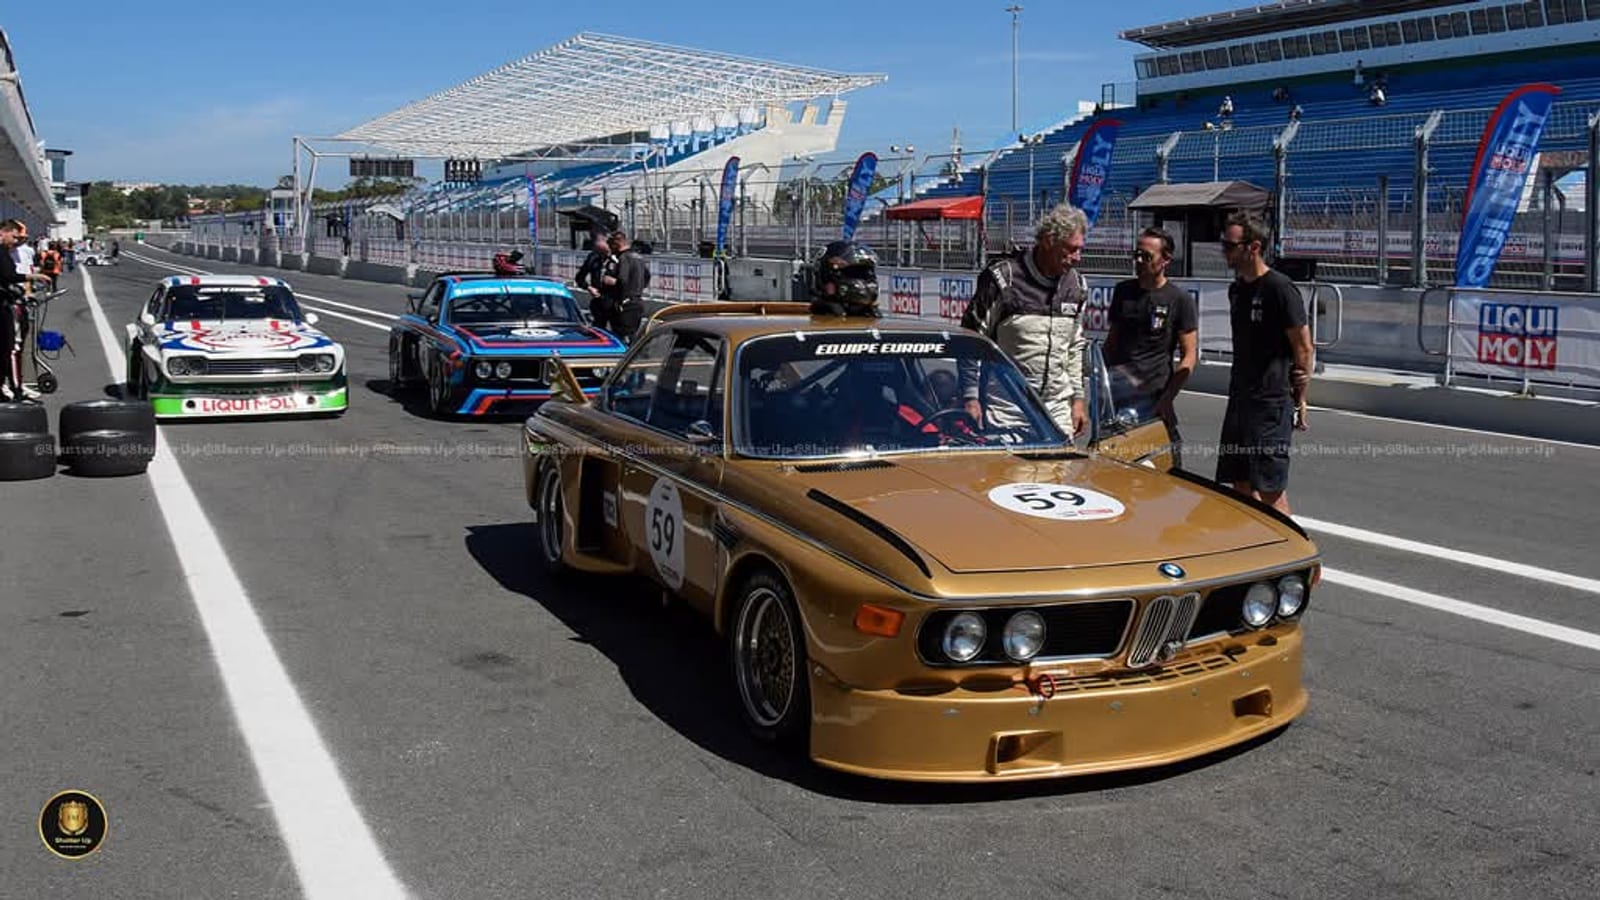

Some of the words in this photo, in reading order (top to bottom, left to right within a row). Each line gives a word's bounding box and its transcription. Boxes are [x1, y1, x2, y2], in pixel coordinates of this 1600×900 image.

[892, 277, 920, 294] LIQUI
[940, 280, 974, 298] LIQUI
[891, 295, 920, 313] MOLY
[1482, 305, 1554, 335] LIQUI
[815, 343, 878, 355] EQUIPE
[880, 343, 945, 354] EUROPE
[1481, 336, 1555, 365] MOLY
[202, 399, 250, 412] LIQUI
[1012, 490, 1086, 511] 59
[652, 507, 675, 557] 59
